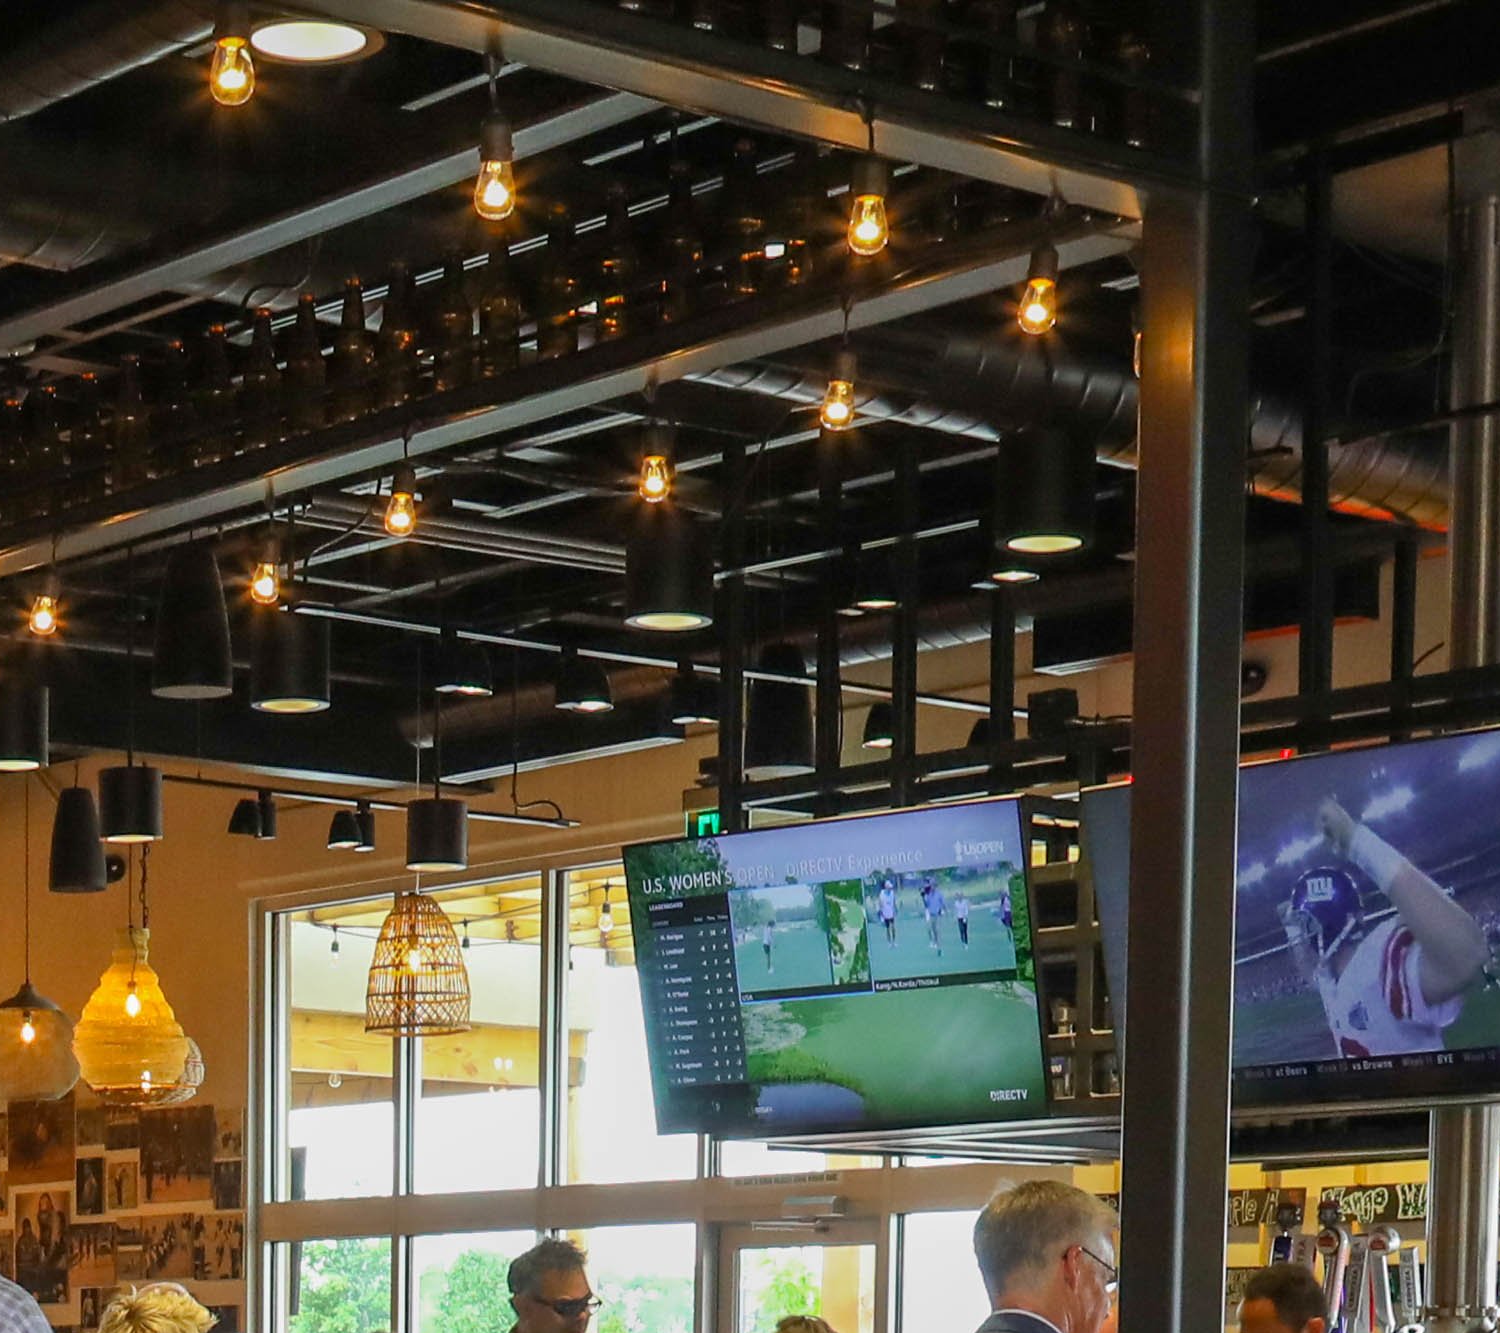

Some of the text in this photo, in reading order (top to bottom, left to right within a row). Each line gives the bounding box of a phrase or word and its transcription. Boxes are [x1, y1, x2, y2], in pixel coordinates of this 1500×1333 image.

[785, 848, 923, 877] DIRECTV Experience
[668, 868, 734, 891] WOMEN'S
[737, 865, 775, 883] OPEN
[989, 1088, 1028, 1102] DIRECTV
